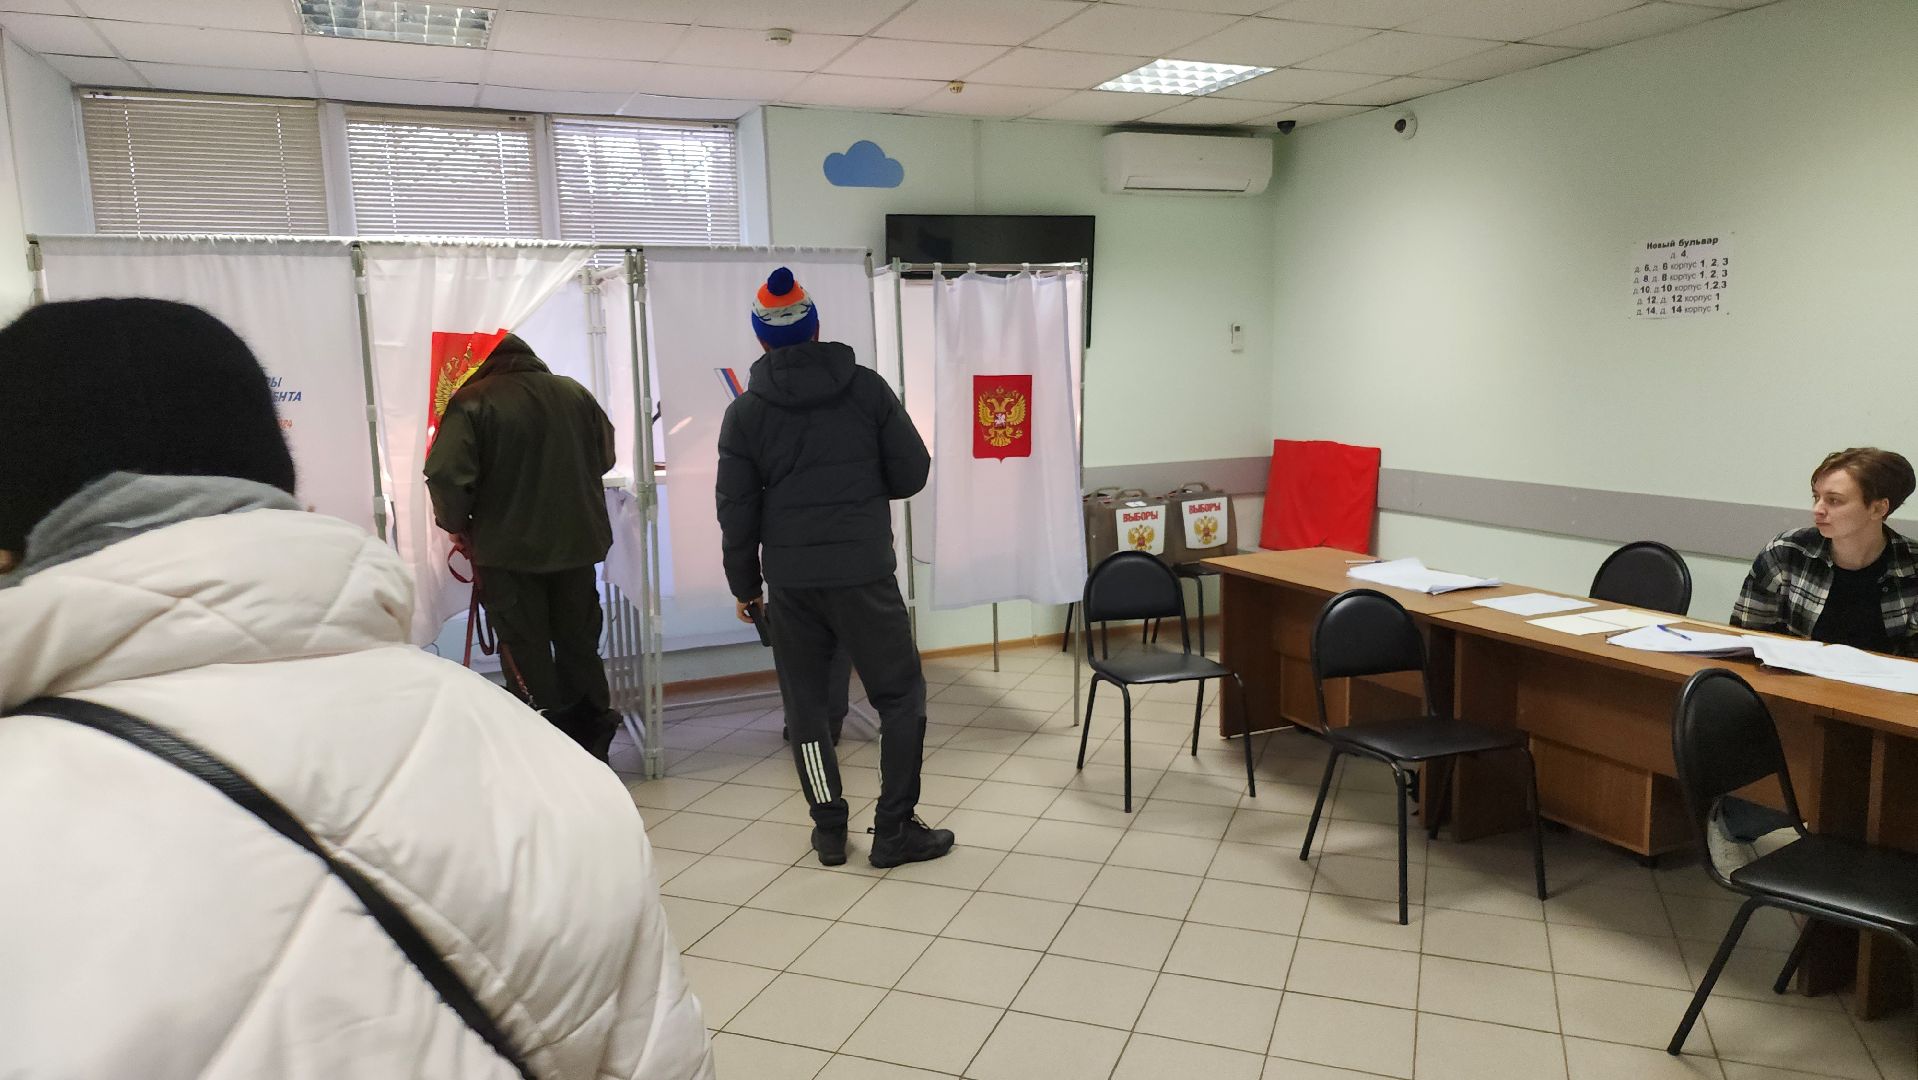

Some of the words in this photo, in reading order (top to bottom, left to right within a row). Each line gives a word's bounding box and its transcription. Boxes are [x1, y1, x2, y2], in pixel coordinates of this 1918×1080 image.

[1646, 239, 1676, 249] Новый
[1678, 237, 1719, 248] бульвар
[1670, 260, 1698, 270] корпус
[1722, 257, 1729, 266] 3
[1669, 272, 1697, 282] корпус
[1721, 269, 1728, 278] 3
[1674, 283, 1702, 292] корпус
[1671, 294, 1683, 303] 12
[1684, 293, 1712, 302] корпус
[1671, 305, 1683, 314] 14
[1684, 304, 1712, 313] корпус
[1188, 502, 1221, 515] ВЫБОРЫ
[1122, 510, 1159, 523] ВЫБОРЫ
